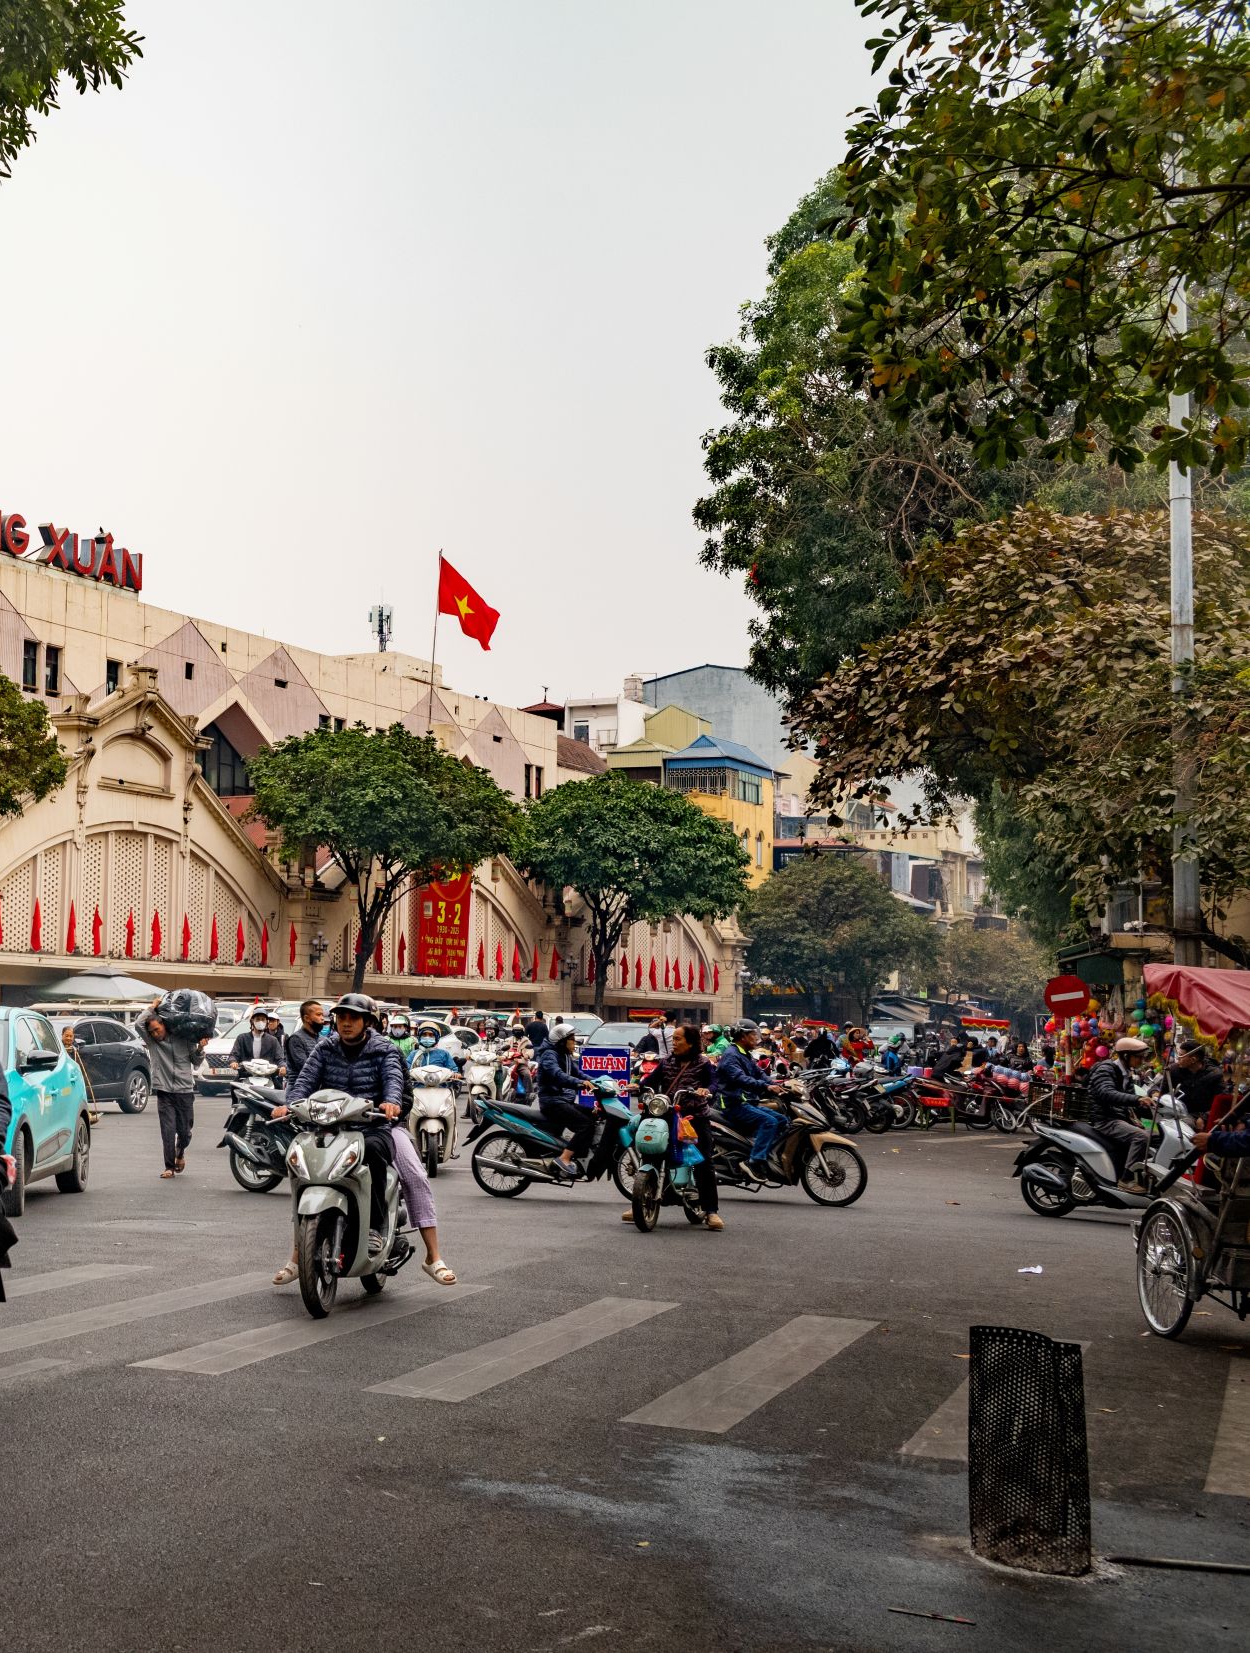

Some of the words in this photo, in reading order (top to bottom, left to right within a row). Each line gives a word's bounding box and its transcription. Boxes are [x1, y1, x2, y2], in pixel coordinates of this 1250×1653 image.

[38, 522, 143, 591] XUÂN
[437, 901, 446, 923] 3
[453, 903, 461, 925] 2
[582, 1054, 627, 1073] NHẬN
